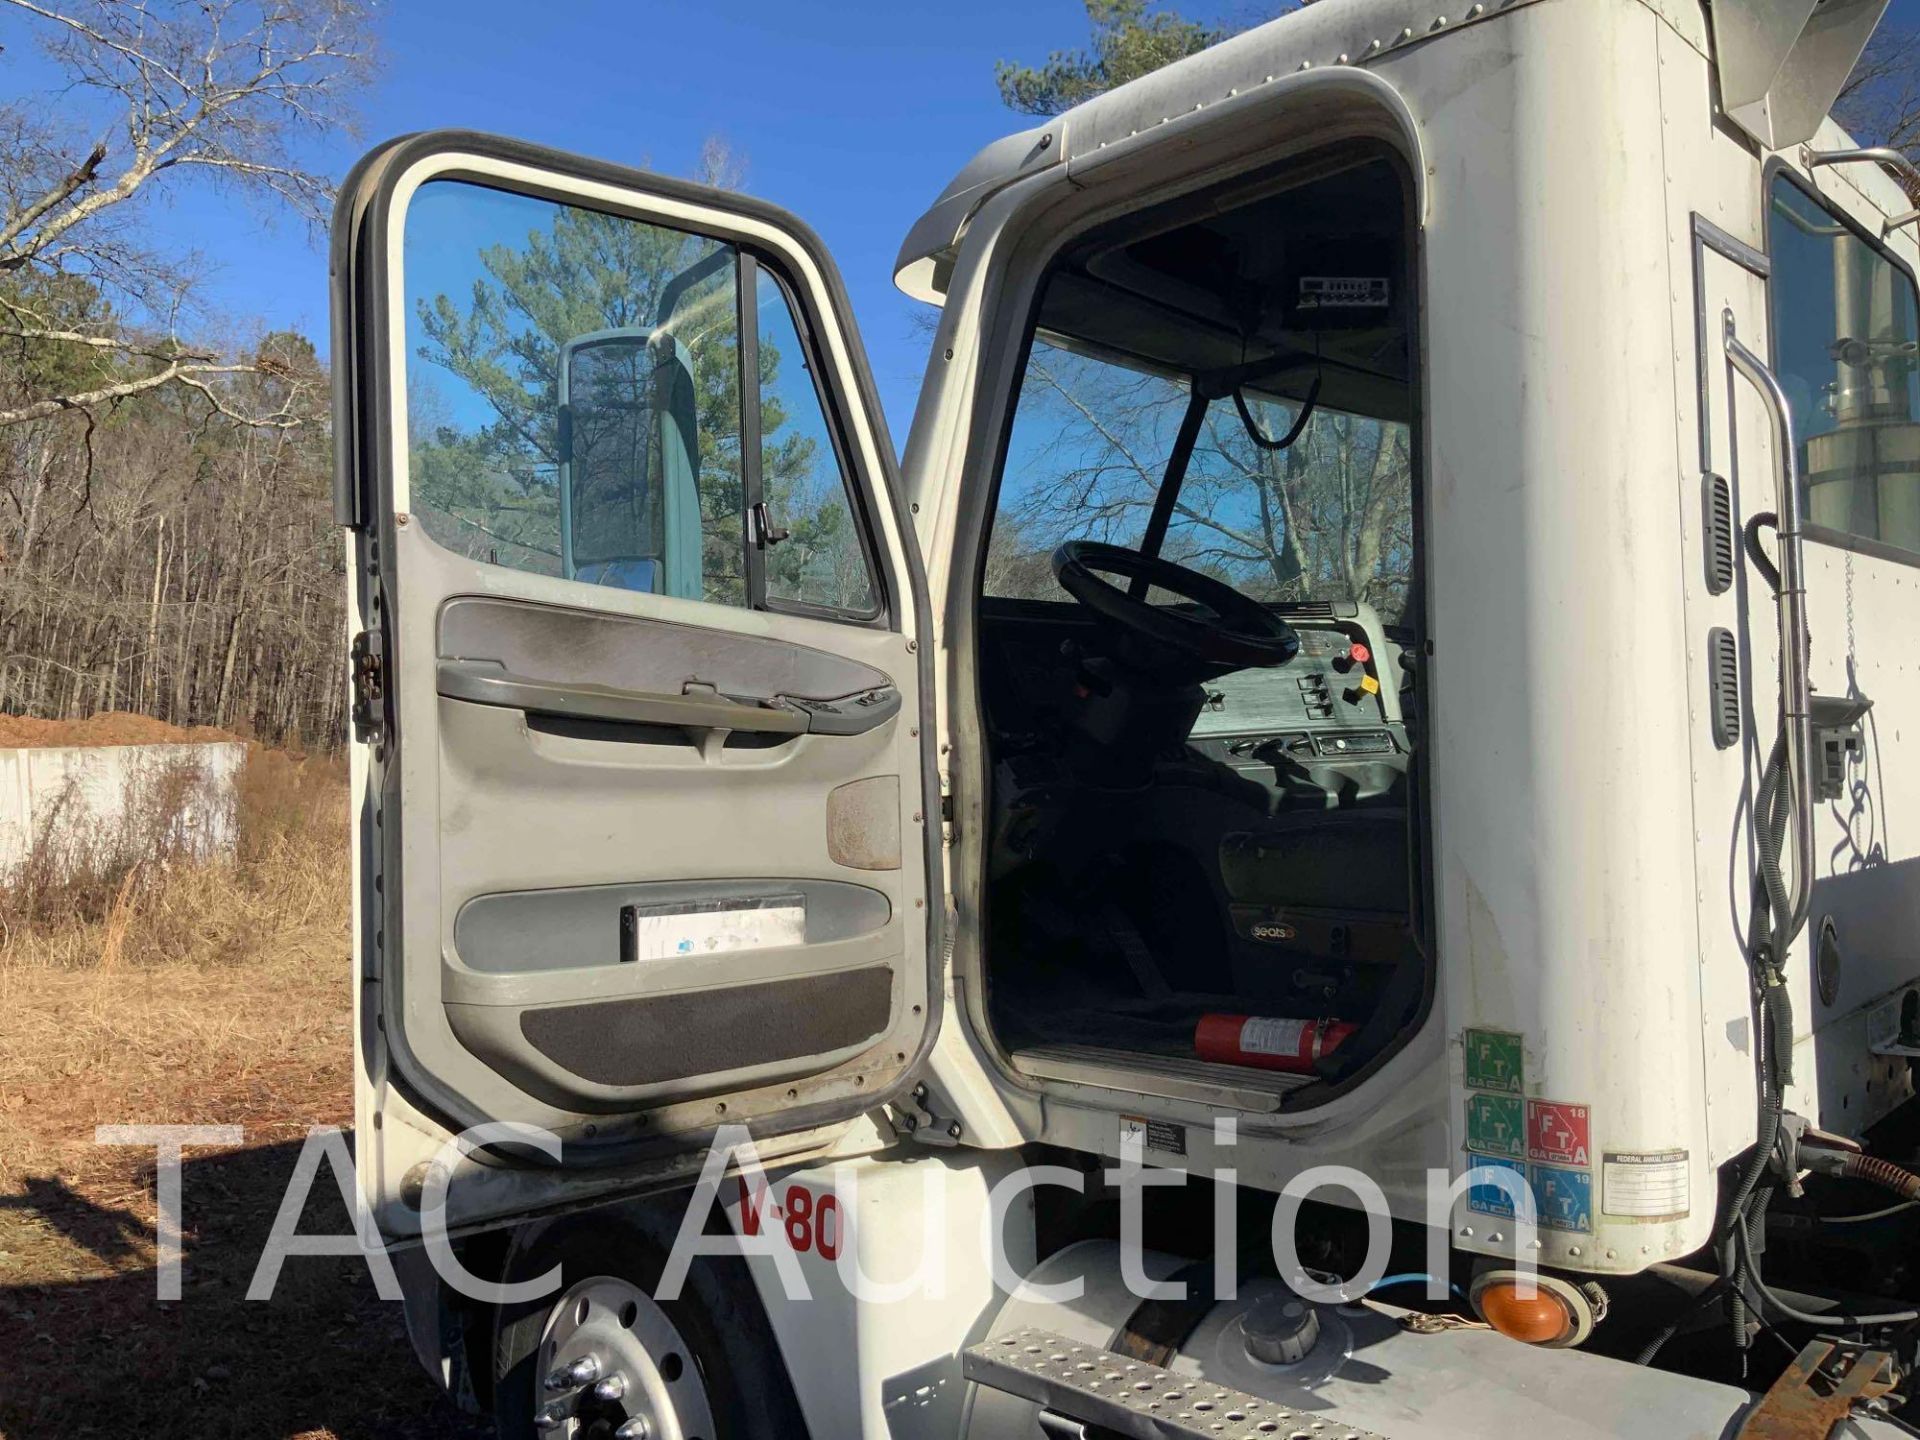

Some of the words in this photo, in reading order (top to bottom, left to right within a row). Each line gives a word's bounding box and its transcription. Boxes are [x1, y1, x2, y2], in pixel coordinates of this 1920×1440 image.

[1254, 926, 1286, 938] seats
[1570, 1108, 1585, 1118] 18
[1529, 1148, 1547, 1159] GA
[1616, 1155, 1642, 1163] FEDERAL
[1575, 1174, 1590, 1184] 19
[738, 1173, 844, 1261] V-80
